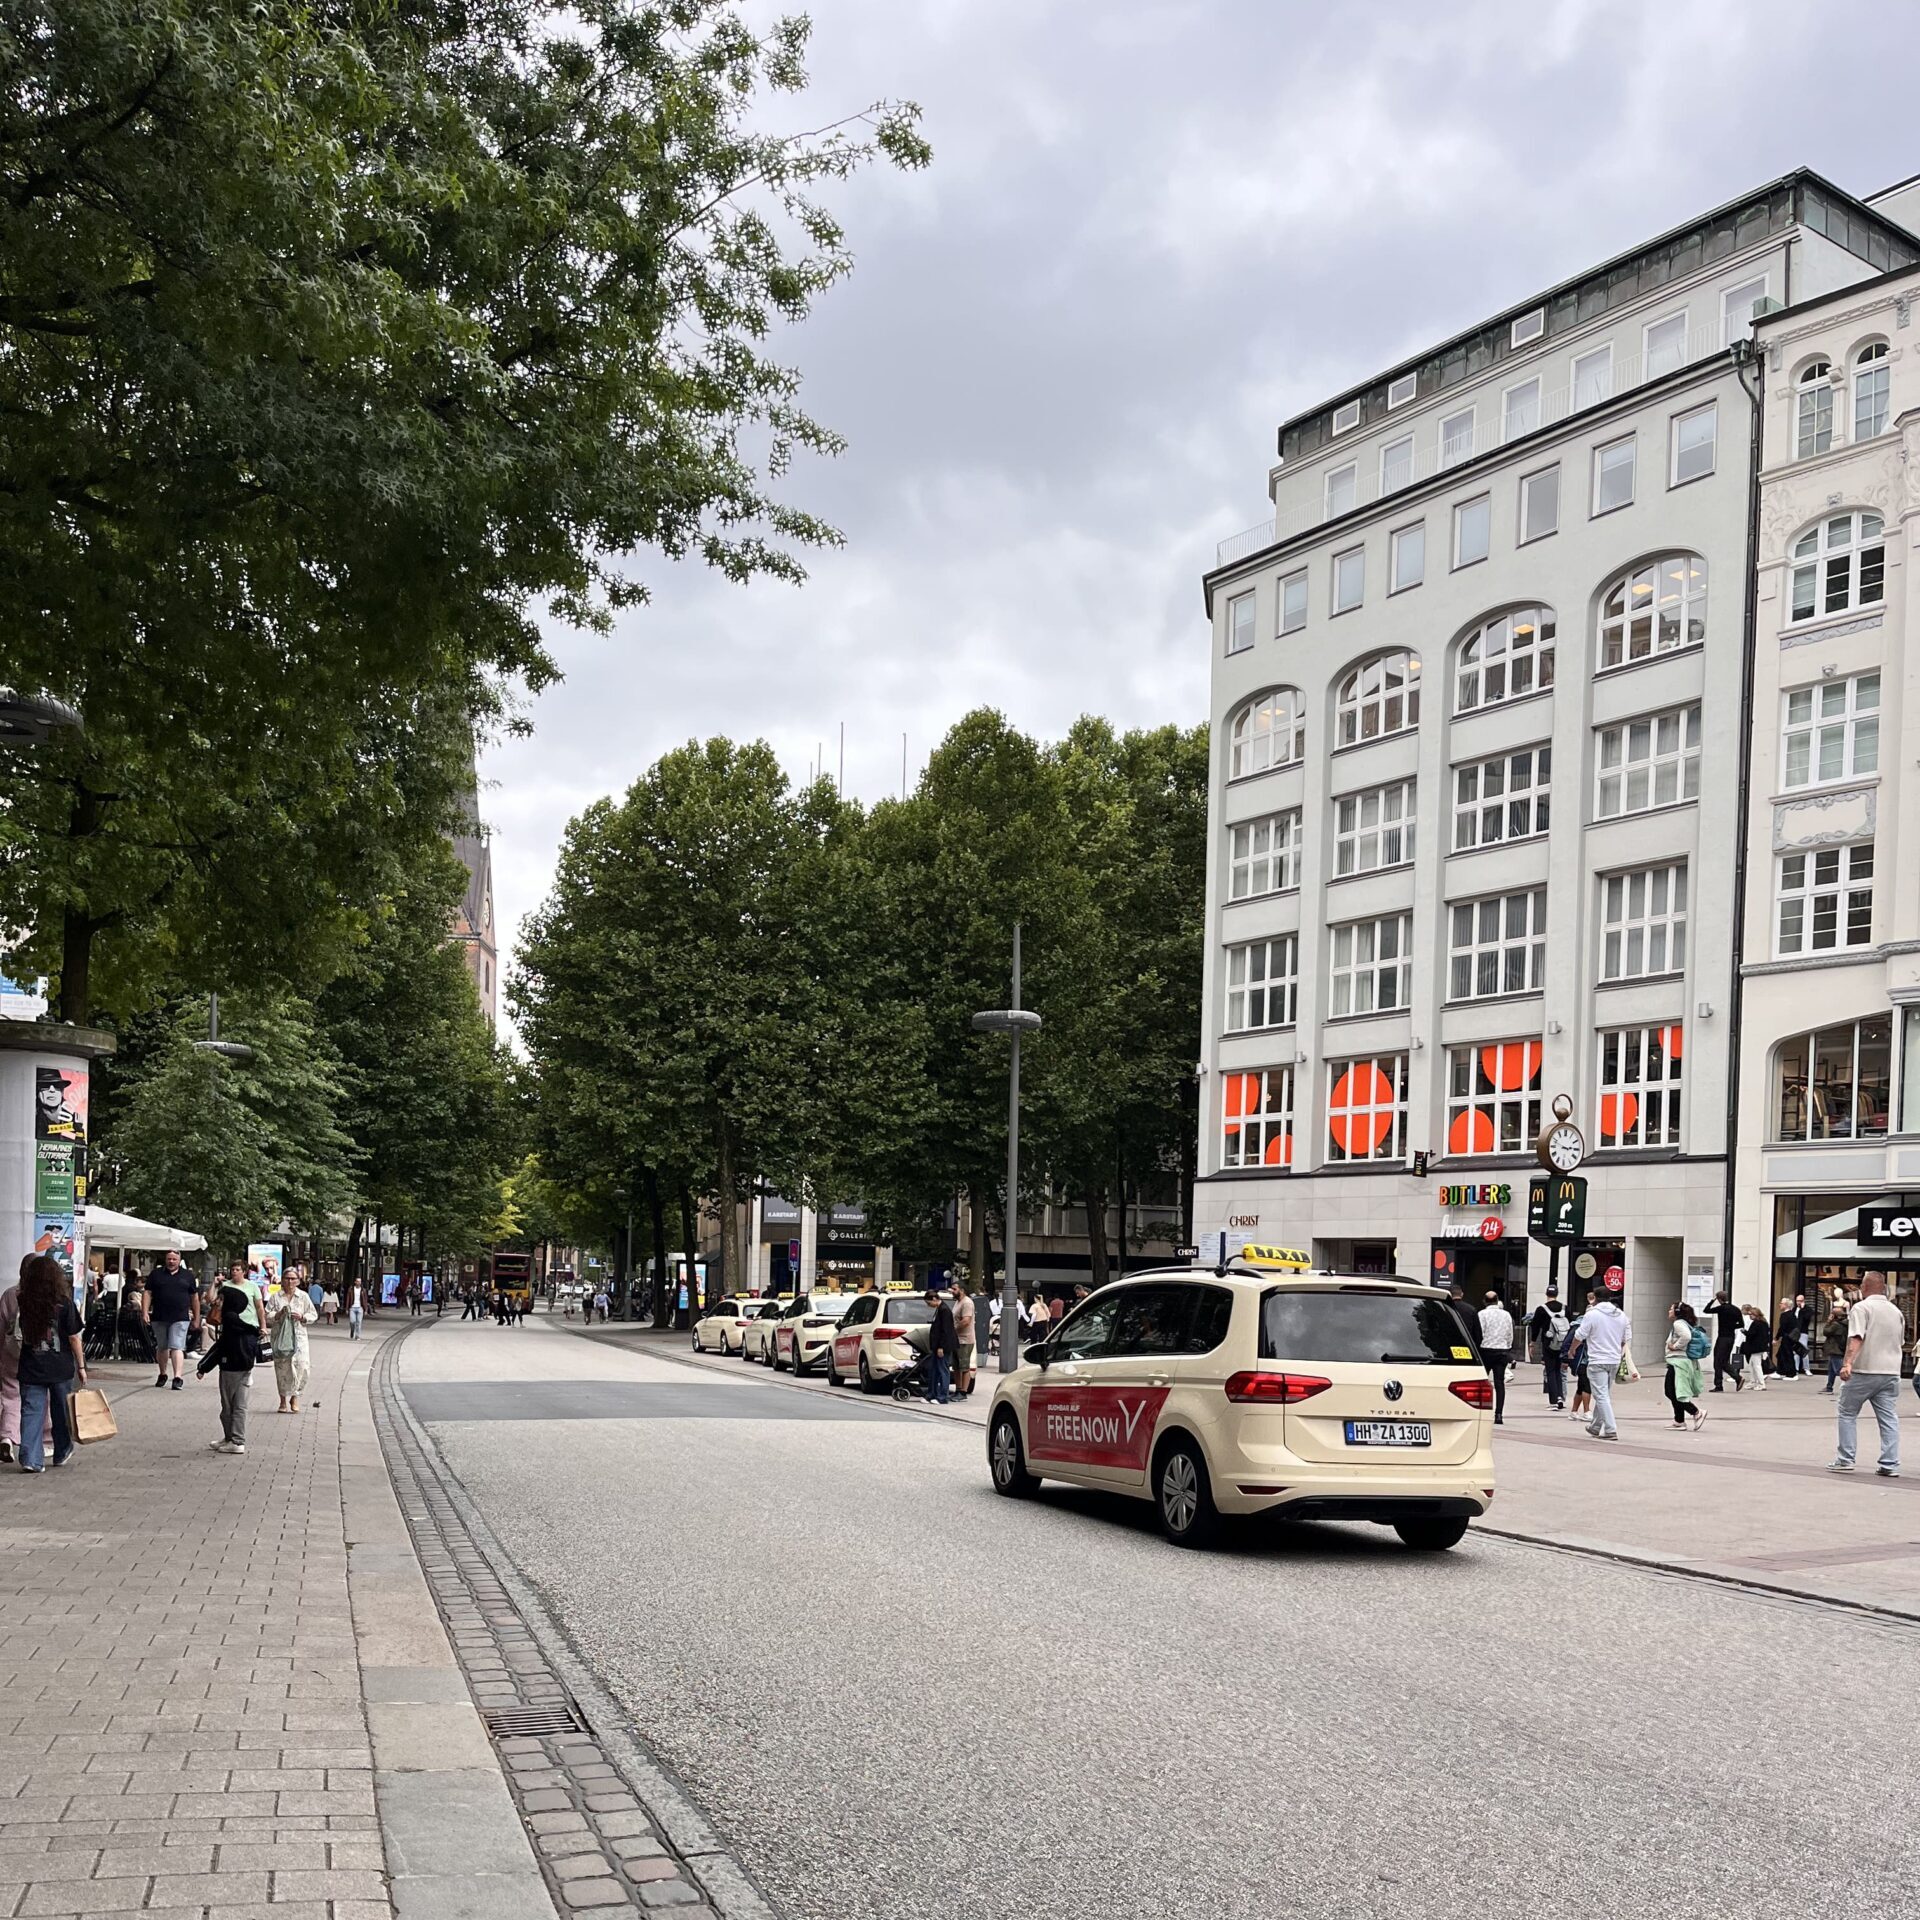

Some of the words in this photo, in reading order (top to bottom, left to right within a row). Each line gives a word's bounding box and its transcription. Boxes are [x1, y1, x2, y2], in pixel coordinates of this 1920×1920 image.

[1439, 1184, 1511, 1206] BUTLERS
[1229, 1215, 1259, 1227] CHRIST
[1177, 1248, 1197, 1256] CHRIST
[1262, 1248, 1304, 1262] TAXI
[1070, 1404, 1080, 1412] AUF
[1047, 1415, 1119, 1444] FREENOW
[1355, 1424, 1372, 1440] HH
[1380, 1424, 1397, 1441] ZA
[1398, 1425, 1429, 1441] 1300
